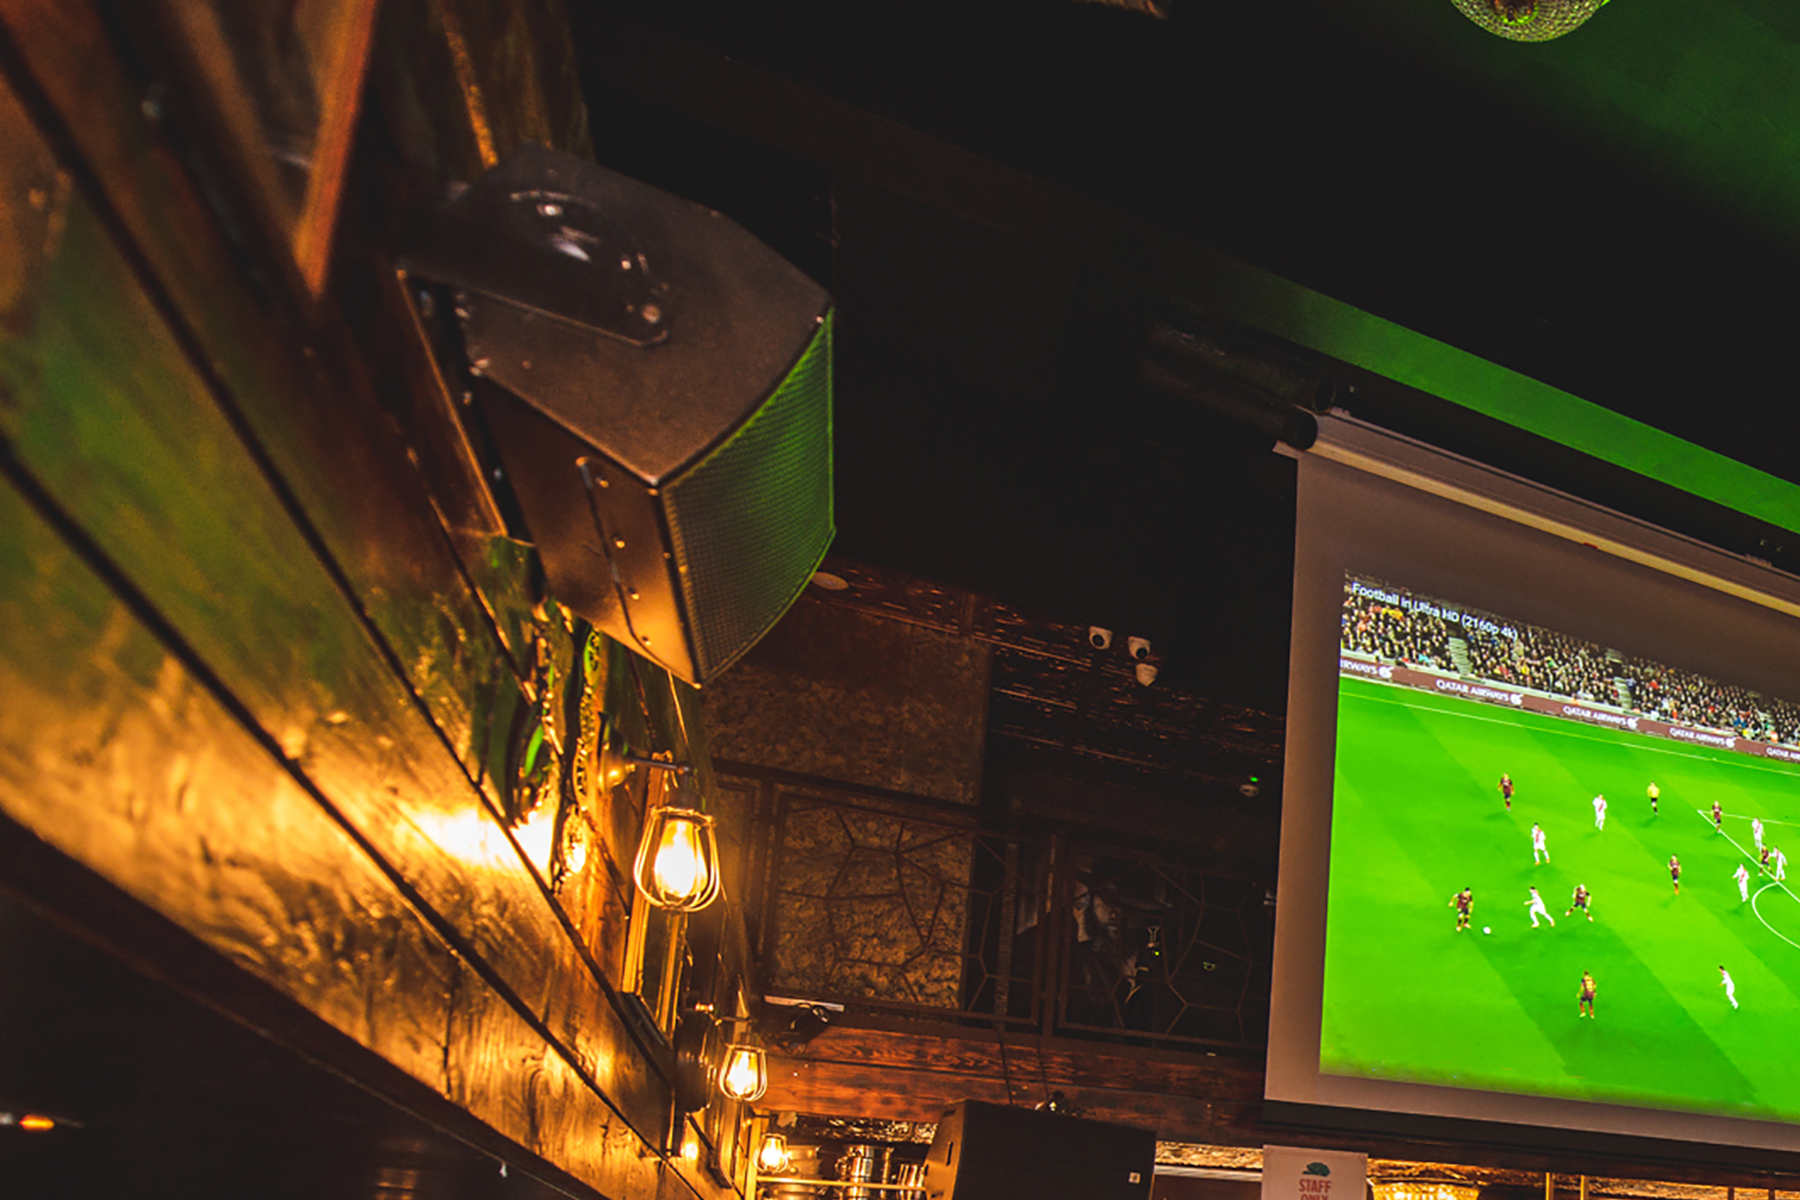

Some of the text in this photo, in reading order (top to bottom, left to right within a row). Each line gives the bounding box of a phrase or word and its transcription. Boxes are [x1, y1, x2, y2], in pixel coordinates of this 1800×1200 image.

[1351, 581, 1399, 605] Football
[1413, 600, 1440, 617] Ultra
[1442, 608, 1460, 622] HD
[1436, 679, 1509, 701] QATAR AIRWAYS
[1563, 705, 1627, 725] QATAR AIRWAYS
[1299, 1178, 1332, 1193] STAFF
